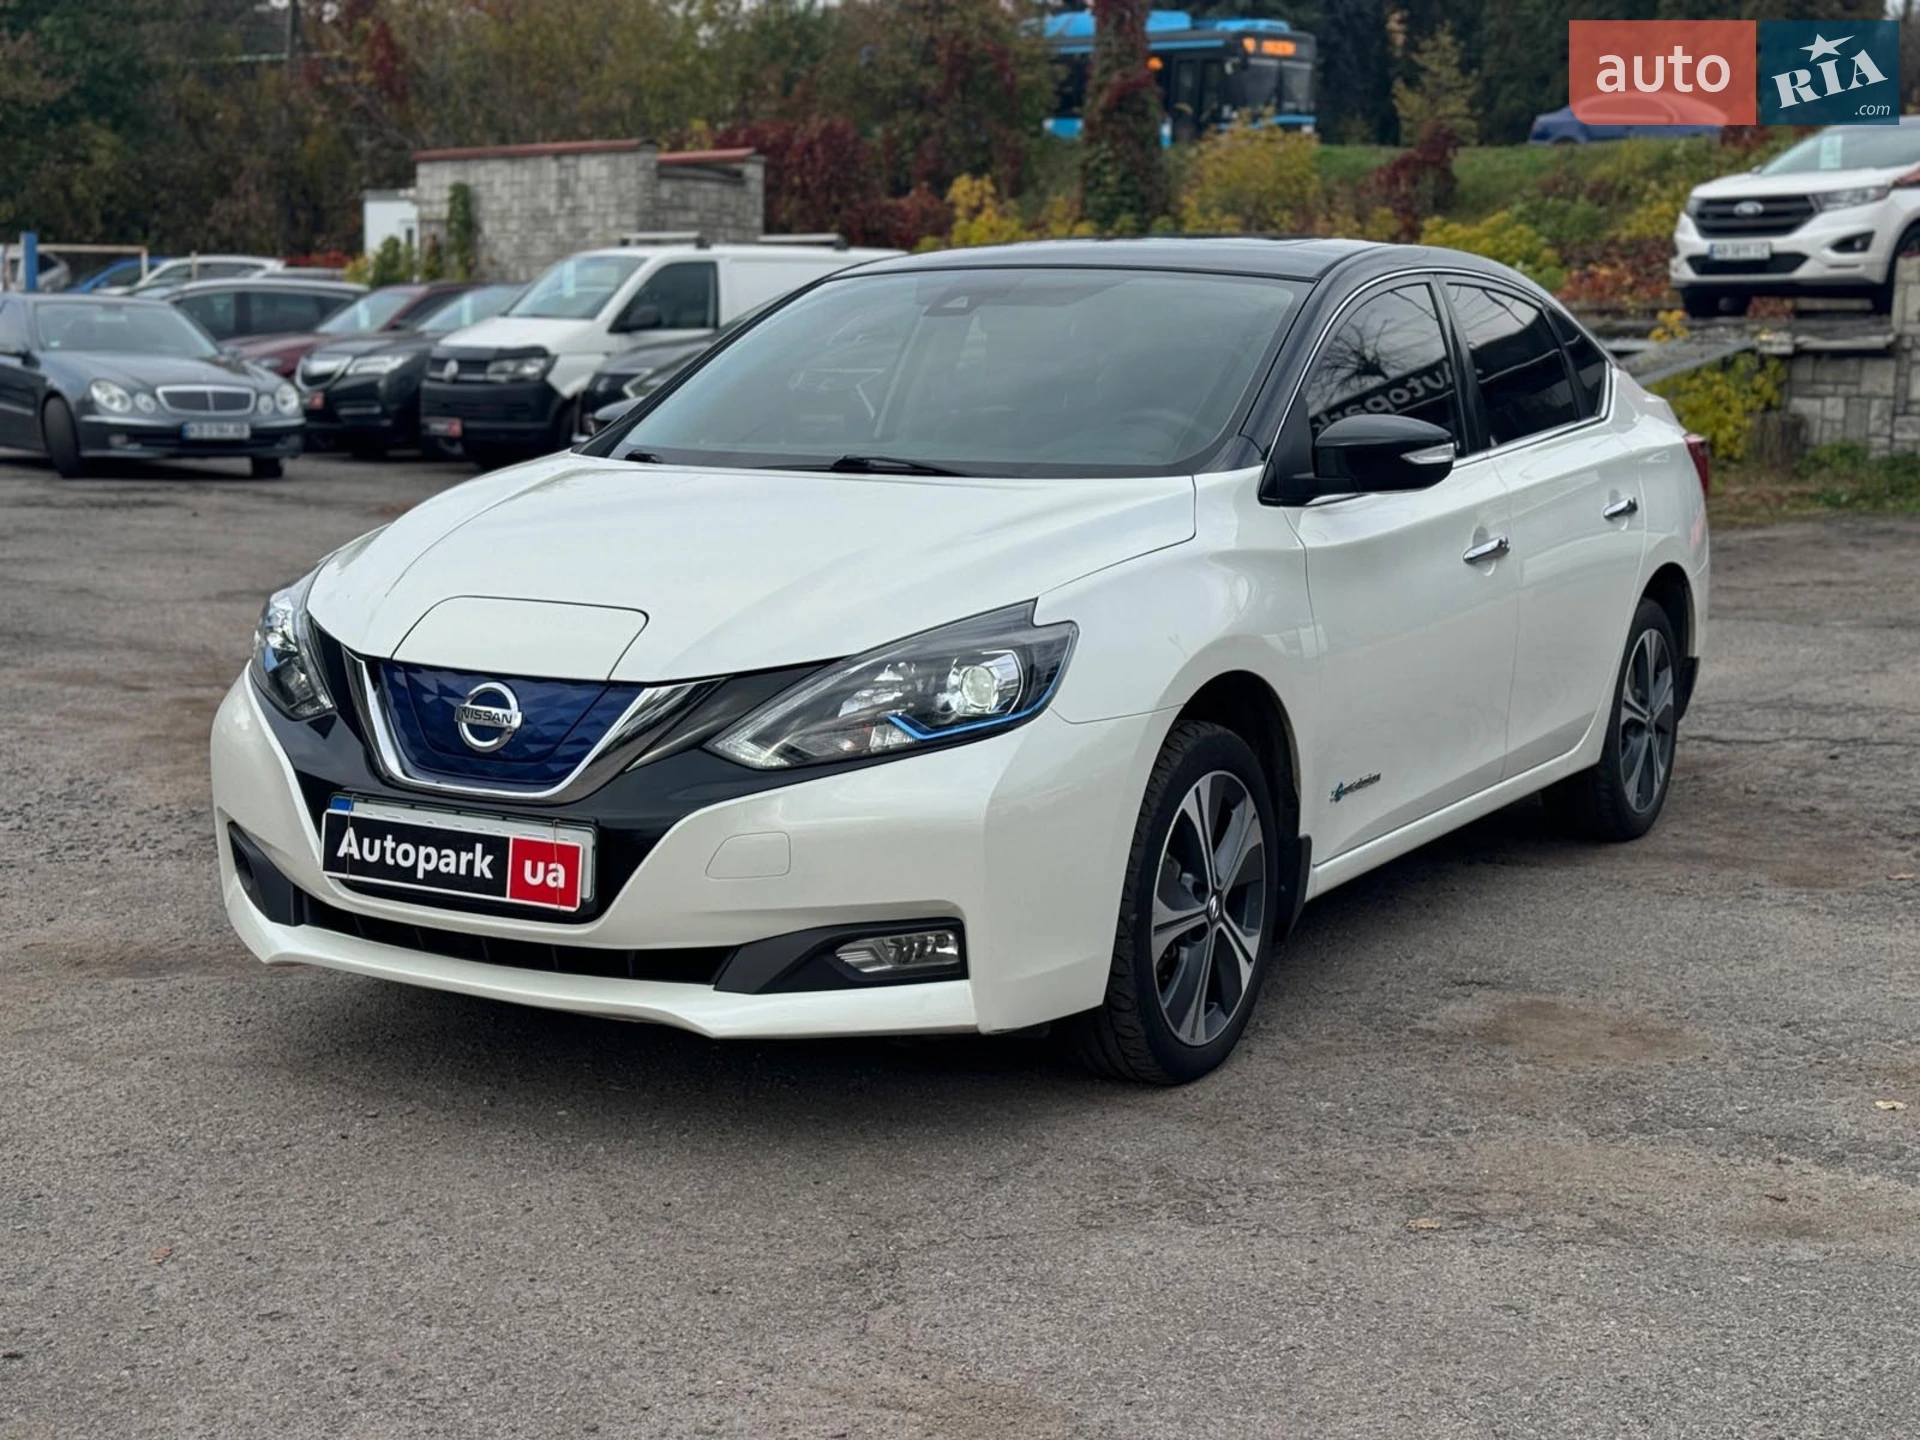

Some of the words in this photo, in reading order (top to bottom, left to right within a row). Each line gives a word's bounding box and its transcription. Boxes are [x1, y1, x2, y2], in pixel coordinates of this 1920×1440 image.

[460, 707, 513, 725] NISSAN
[337, 826, 493, 880] Autopark
[523, 858, 566, 888] ua
